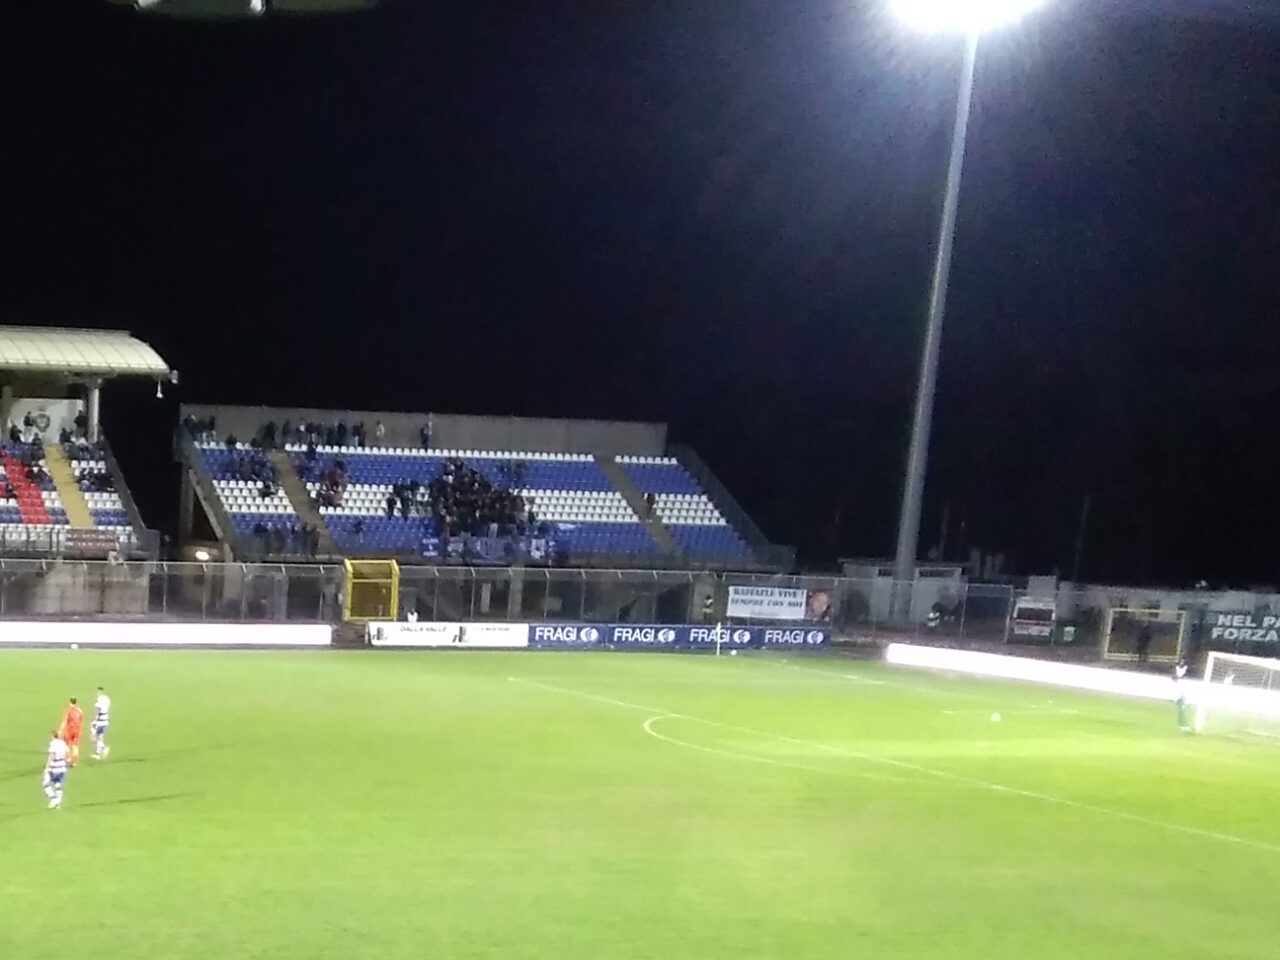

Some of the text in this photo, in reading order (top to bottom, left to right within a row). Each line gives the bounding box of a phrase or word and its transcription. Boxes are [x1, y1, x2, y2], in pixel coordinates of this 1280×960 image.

[1217, 614, 1257, 627] NEL
[535, 626, 805, 644] FRAGI FRAGI FRAGI FRAGI
[1212, 627, 1279, 642] FORZA
